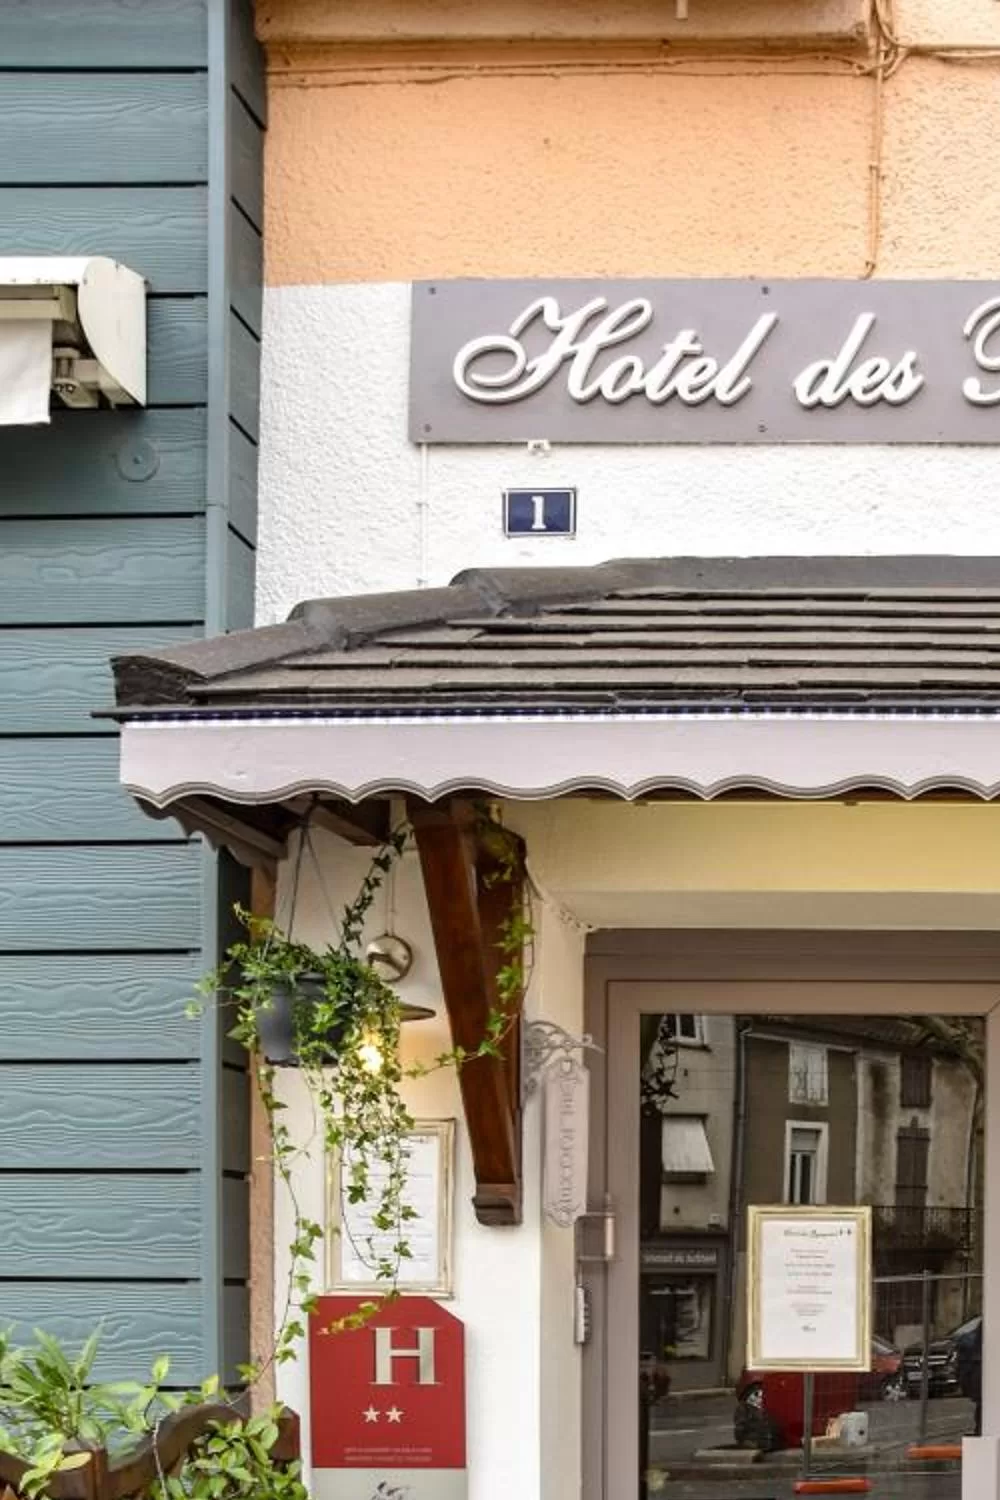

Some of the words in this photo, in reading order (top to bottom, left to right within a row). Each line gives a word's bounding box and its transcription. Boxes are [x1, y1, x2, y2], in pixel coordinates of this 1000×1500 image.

[453, 296, 779, 406] Hotel
[794, 312, 927, 410] des
[530, 495, 547, 531] 1
[370, 1326, 442, 1386] H
